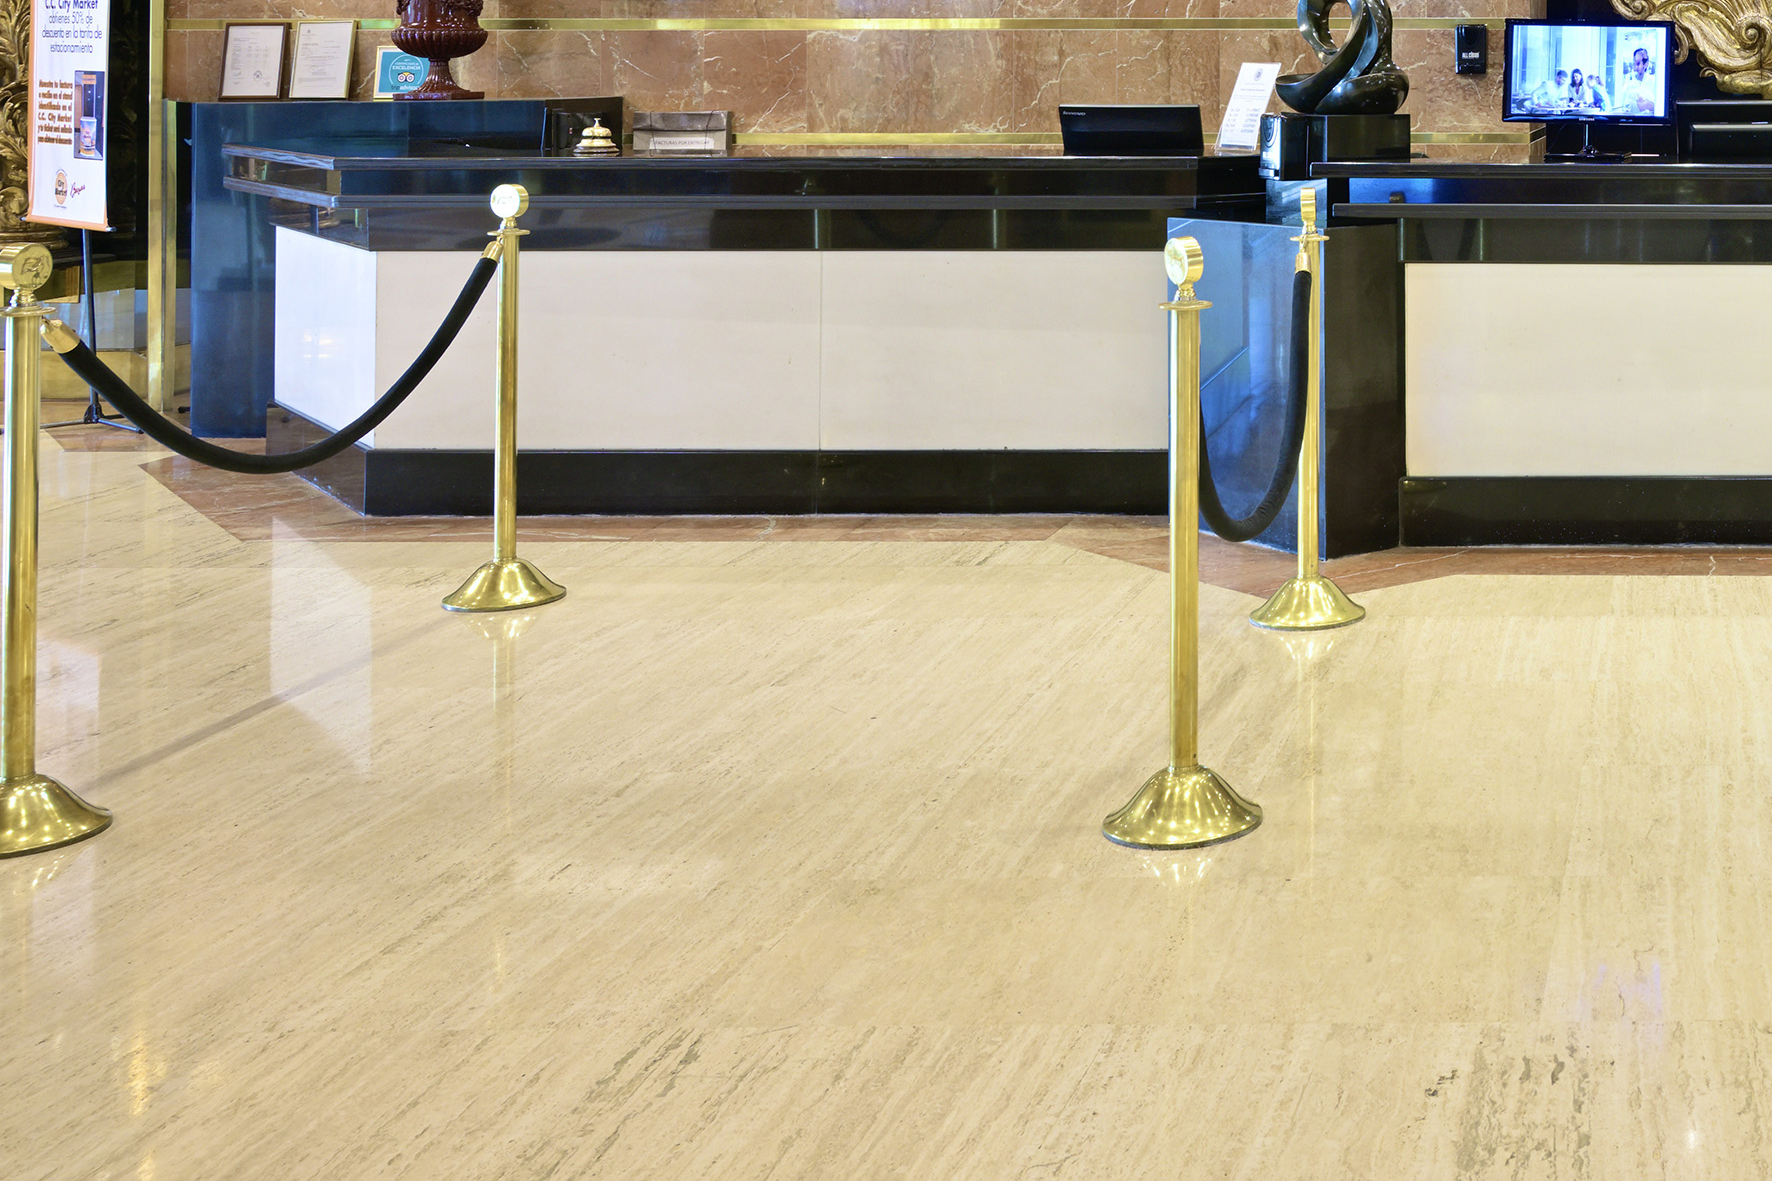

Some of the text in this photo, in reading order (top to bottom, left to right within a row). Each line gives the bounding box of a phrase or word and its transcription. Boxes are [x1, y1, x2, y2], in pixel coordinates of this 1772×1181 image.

[49, 9, 93, 24] obtienes 50% de
[42, 23, 103, 39] descuento en la tarifa de
[50, 40, 93, 54] estacionamiento
